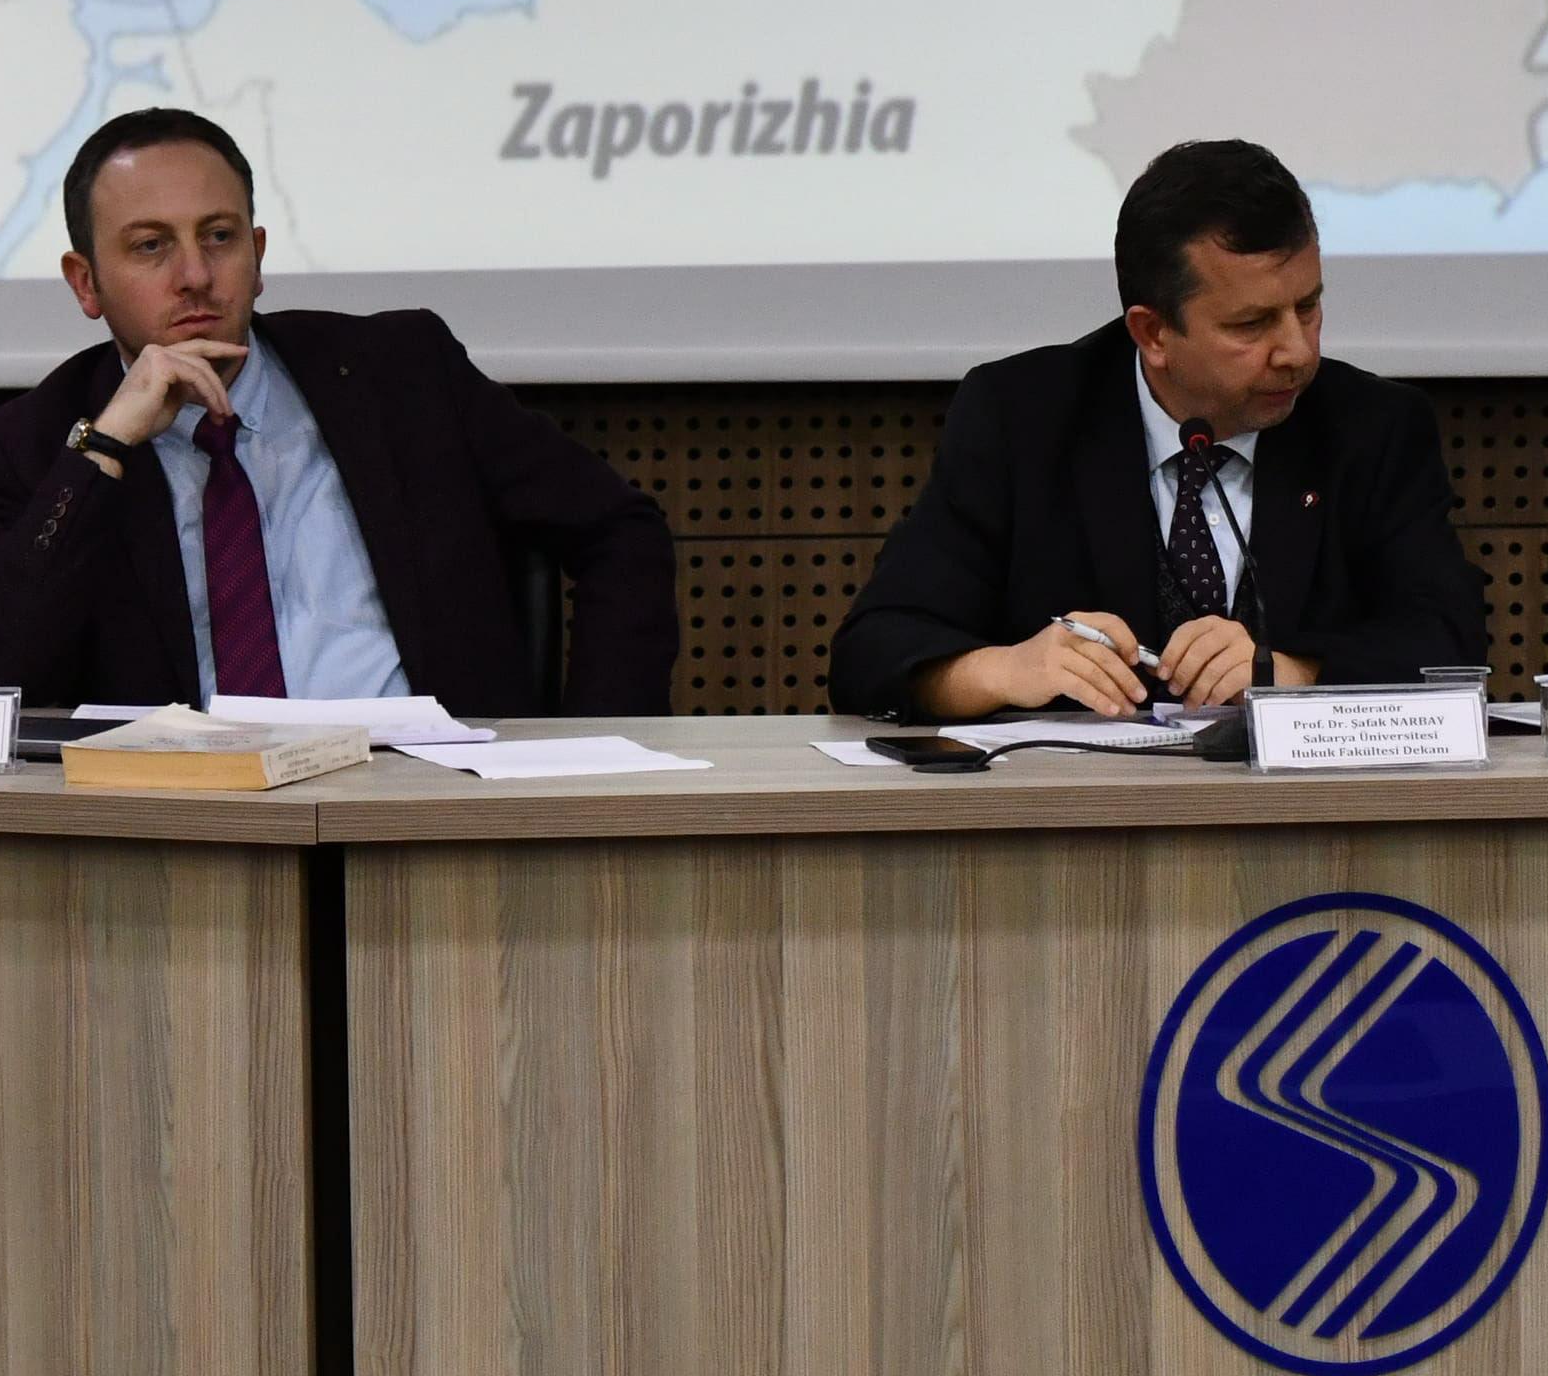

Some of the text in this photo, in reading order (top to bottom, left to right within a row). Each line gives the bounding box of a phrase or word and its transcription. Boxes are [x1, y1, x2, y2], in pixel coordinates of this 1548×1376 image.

[499, 76, 917, 181] Zaporizhia
[1331, 703, 1404, 715] Moderatör
[1293, 715, 1446, 730] Prof. Dr. Şafak NARBAY
[1302, 730, 1439, 745] Sakarya Üniversitesi
[1291, 744, 1450, 759] Hukuk Fakültesi Dekanı
